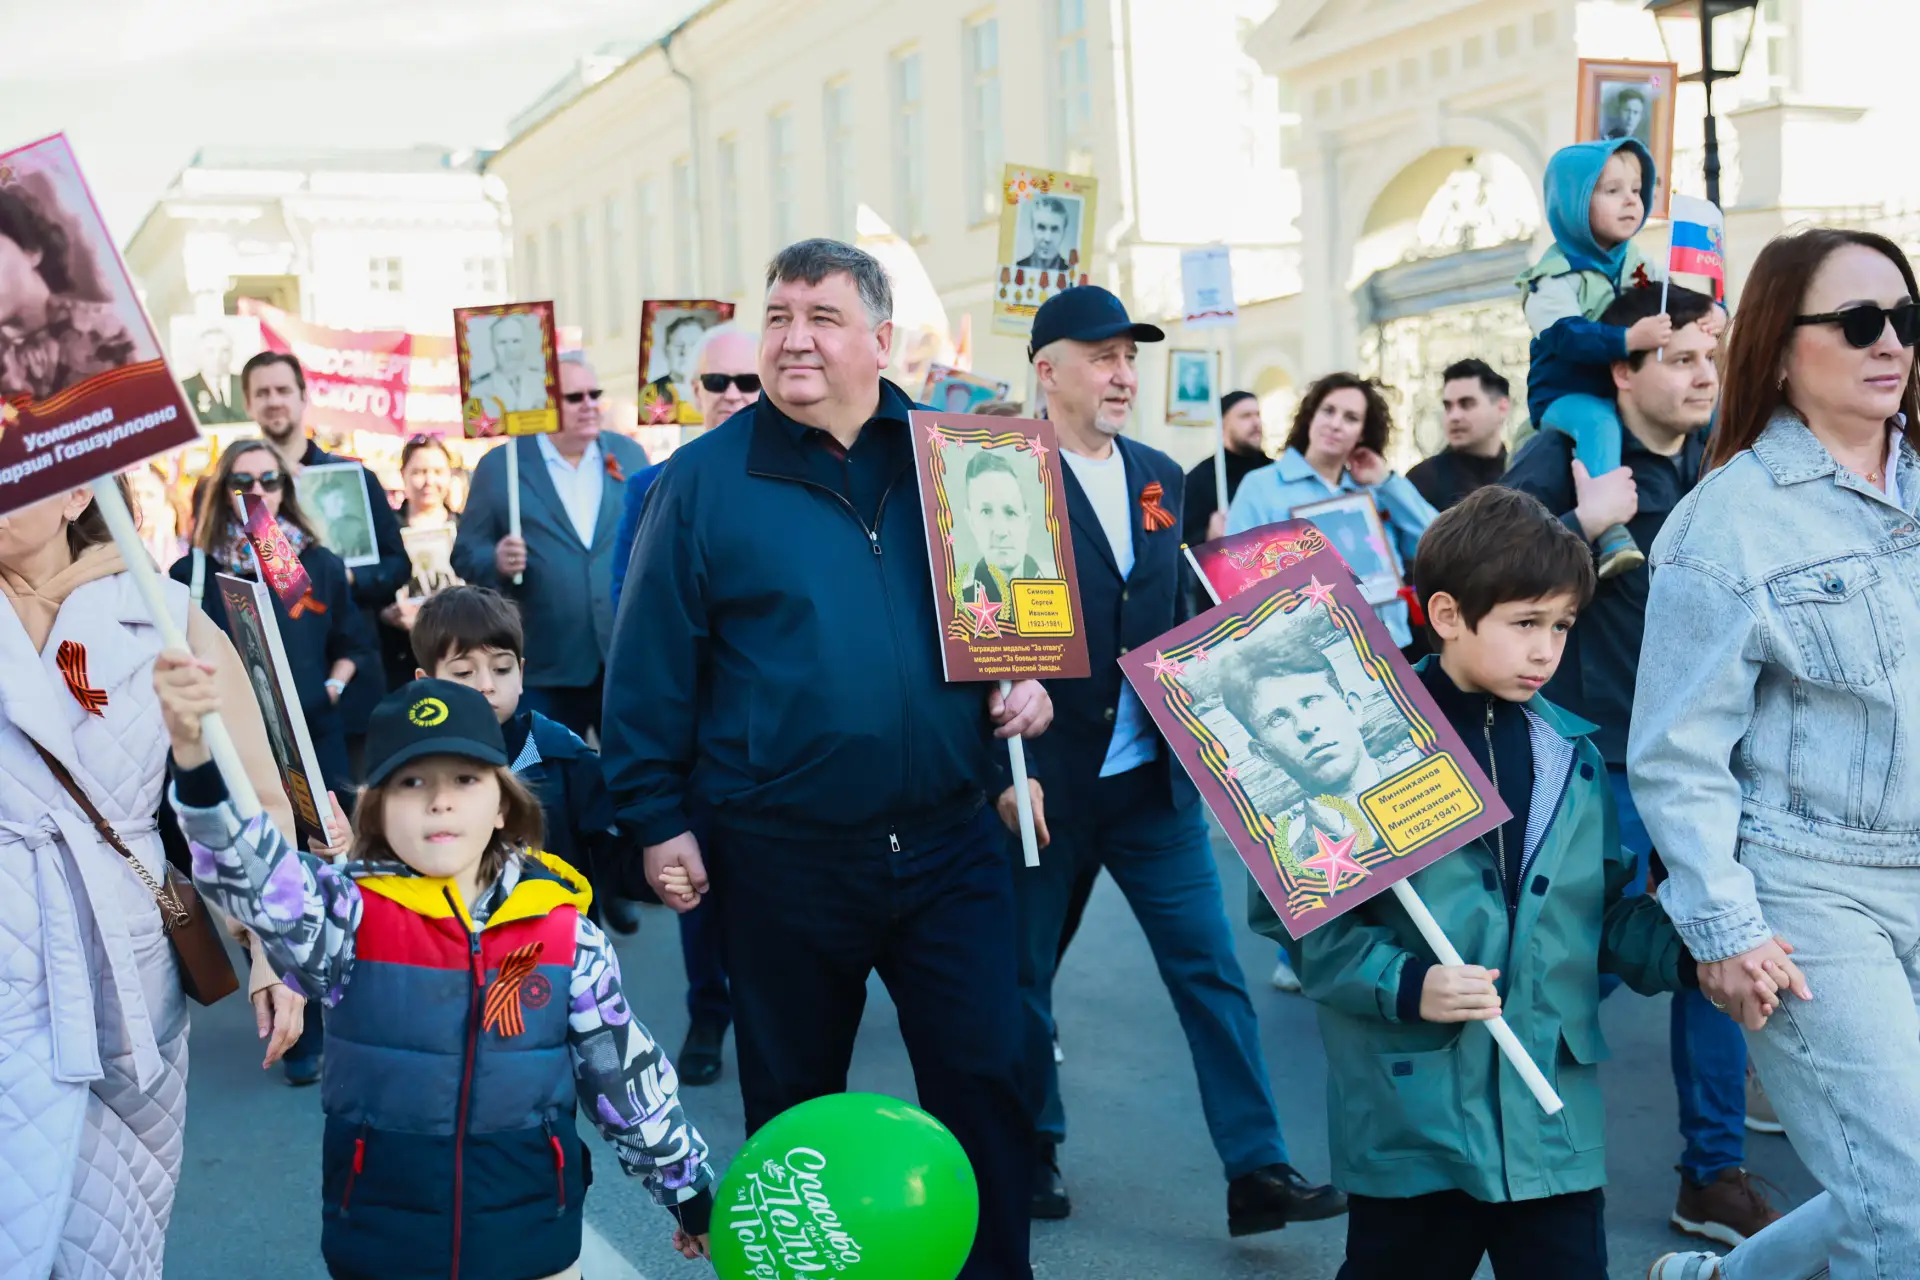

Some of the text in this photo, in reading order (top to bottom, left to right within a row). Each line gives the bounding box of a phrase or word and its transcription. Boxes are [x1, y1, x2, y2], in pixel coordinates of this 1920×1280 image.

[0, 405, 177, 485] арзия Газизулловна
[23, 407, 114, 452] Усманова
[1011, 664, 1037, 673] Красной
[1378, 768, 1441, 804] Минниханов
[1391, 783, 1441, 812] Галимзян
[1387, 788, 1461, 831] Минниханович
[1404, 803, 1461, 839] (1922-1941)
[785, 1147, 862, 1263] Спасибо
